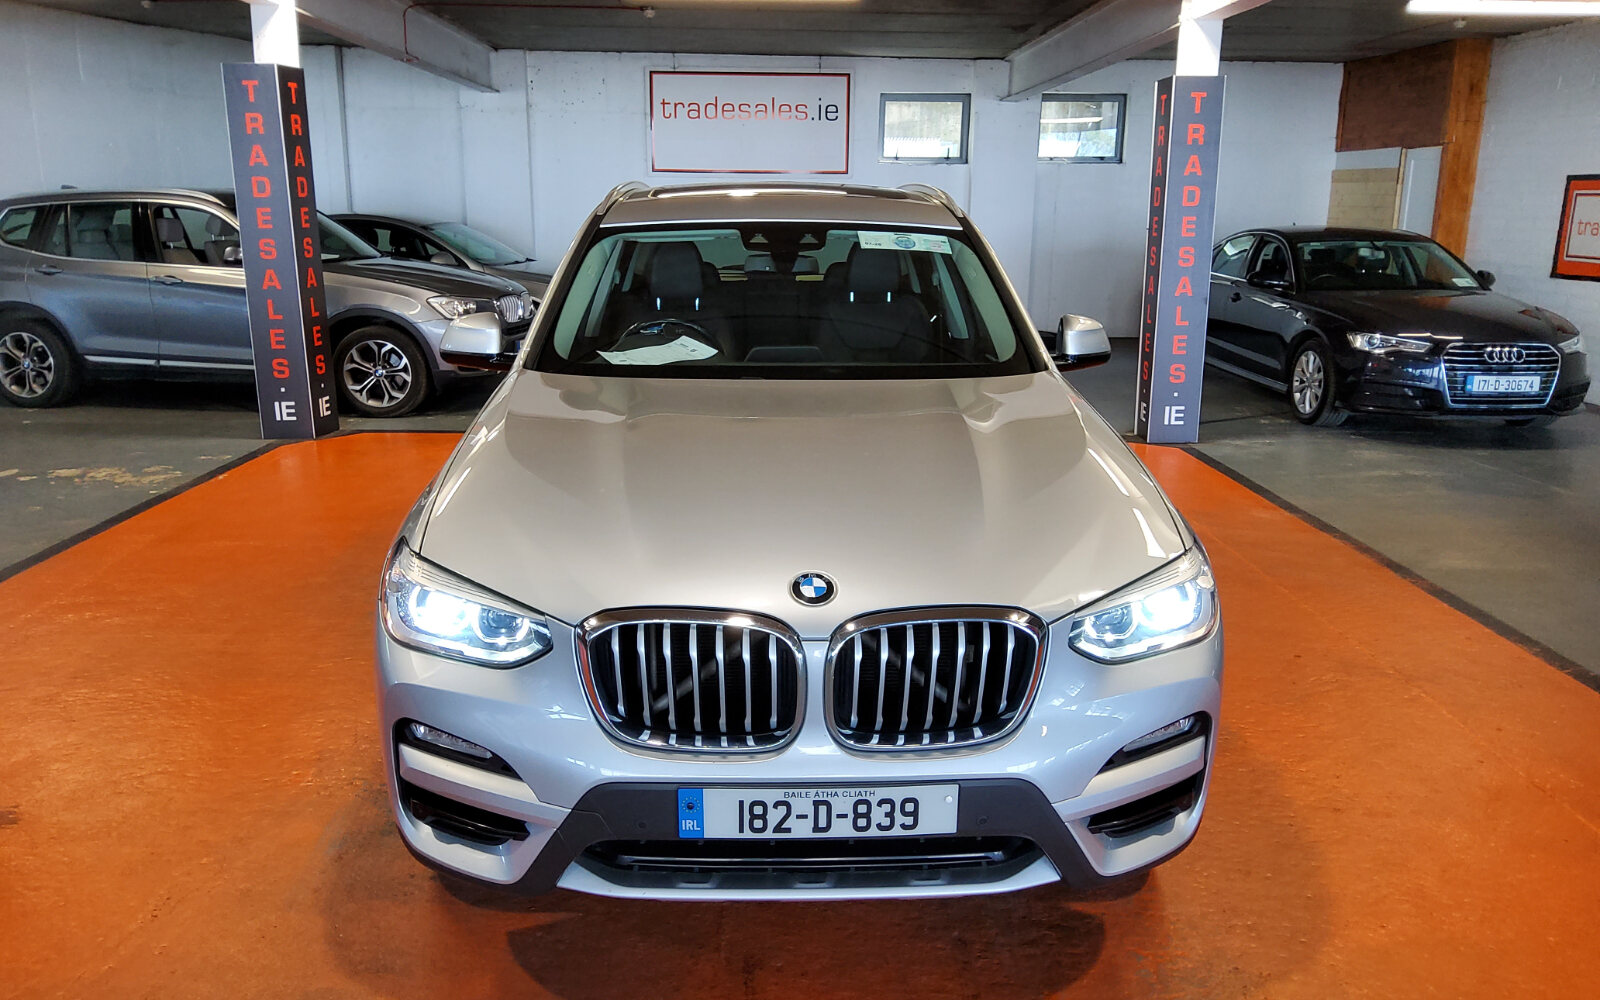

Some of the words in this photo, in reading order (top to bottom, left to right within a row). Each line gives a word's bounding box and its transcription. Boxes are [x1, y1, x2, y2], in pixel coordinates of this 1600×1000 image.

[660, 95, 839, 122] tradesales.ie
[1577, 218, 1600, 237] tra
[1477, 379, 1534, 391] 171-D-30674
[783, 791, 811, 799] BAILE
[842, 790, 876, 798] CLIATH
[738, 797, 920, 834] 182-D-839
[681, 819, 701, 831] IRL
